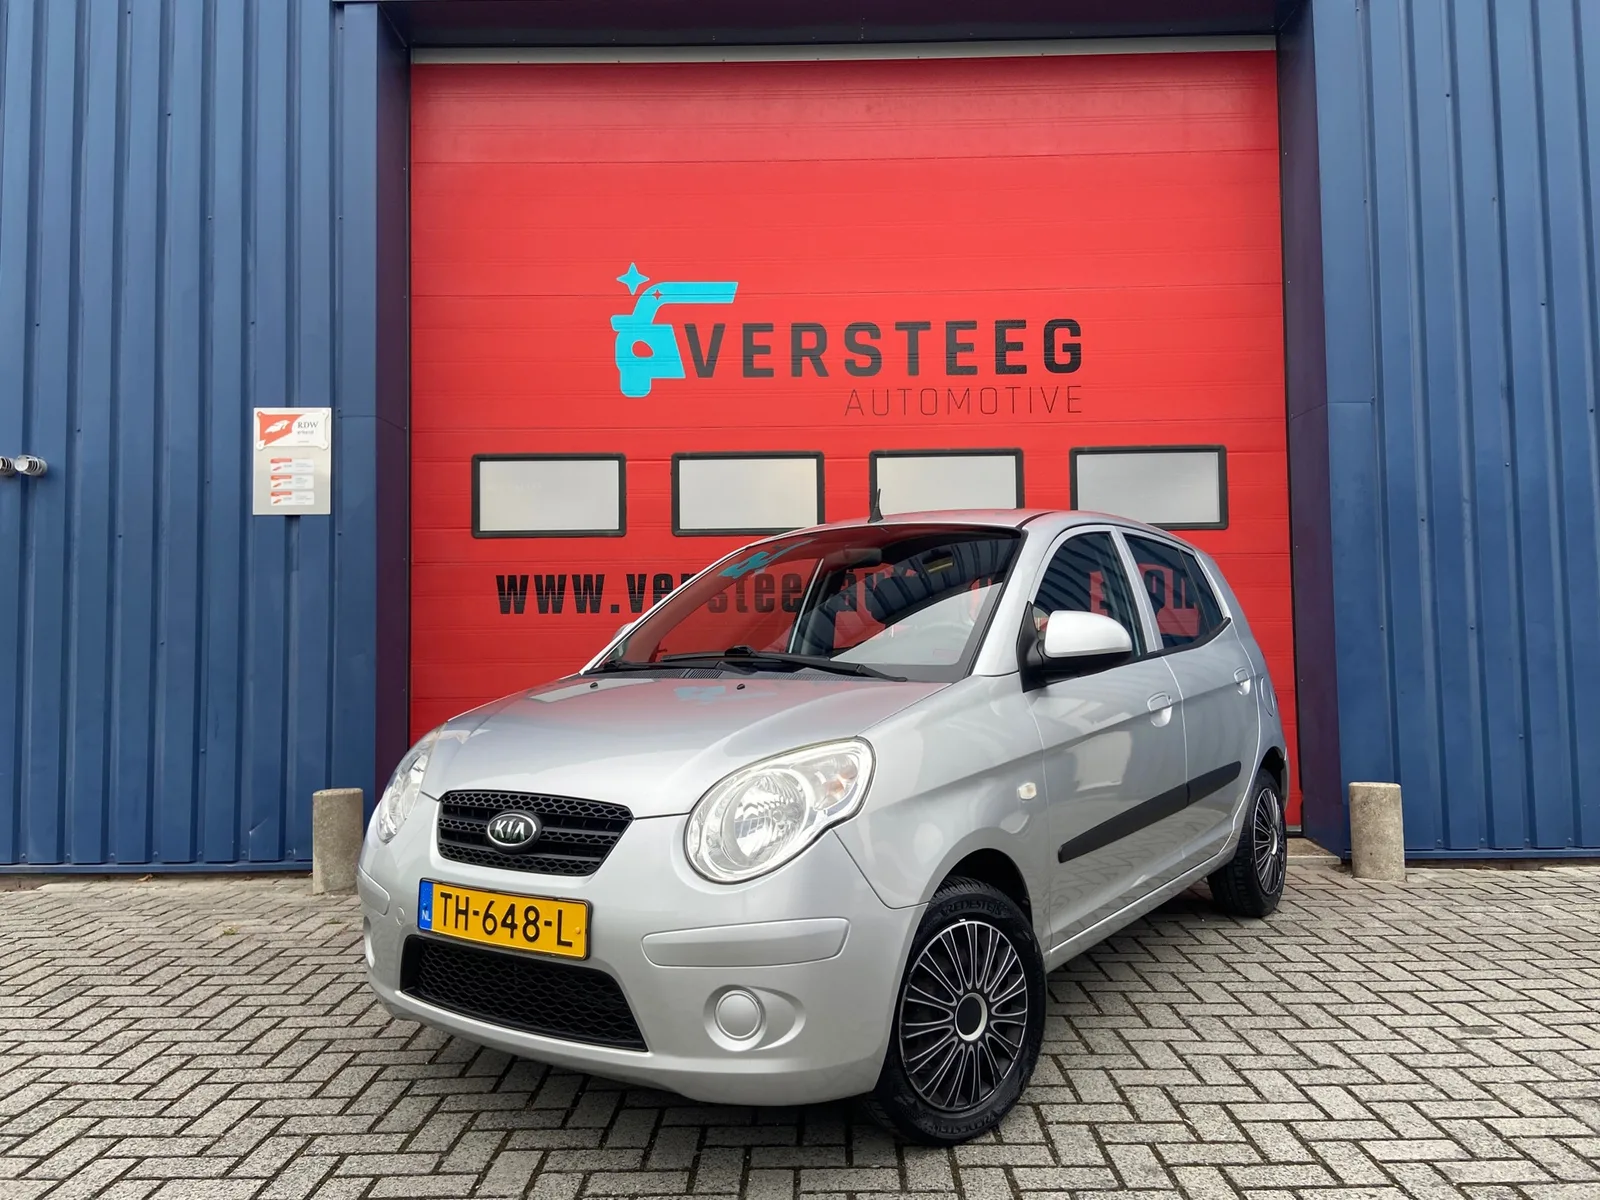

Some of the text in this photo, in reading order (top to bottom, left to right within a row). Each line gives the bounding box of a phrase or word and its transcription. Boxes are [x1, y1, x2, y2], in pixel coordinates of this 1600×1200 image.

[683, 318, 1082, 379] VERSTEEG
[845, 385, 1082, 416] AUTOMOTIVE
[297, 421, 319, 429] RDW
[494, 818, 526, 840] KIA
[421, 909, 432, 922] NL
[440, 891, 573, 948] TH-648-L
